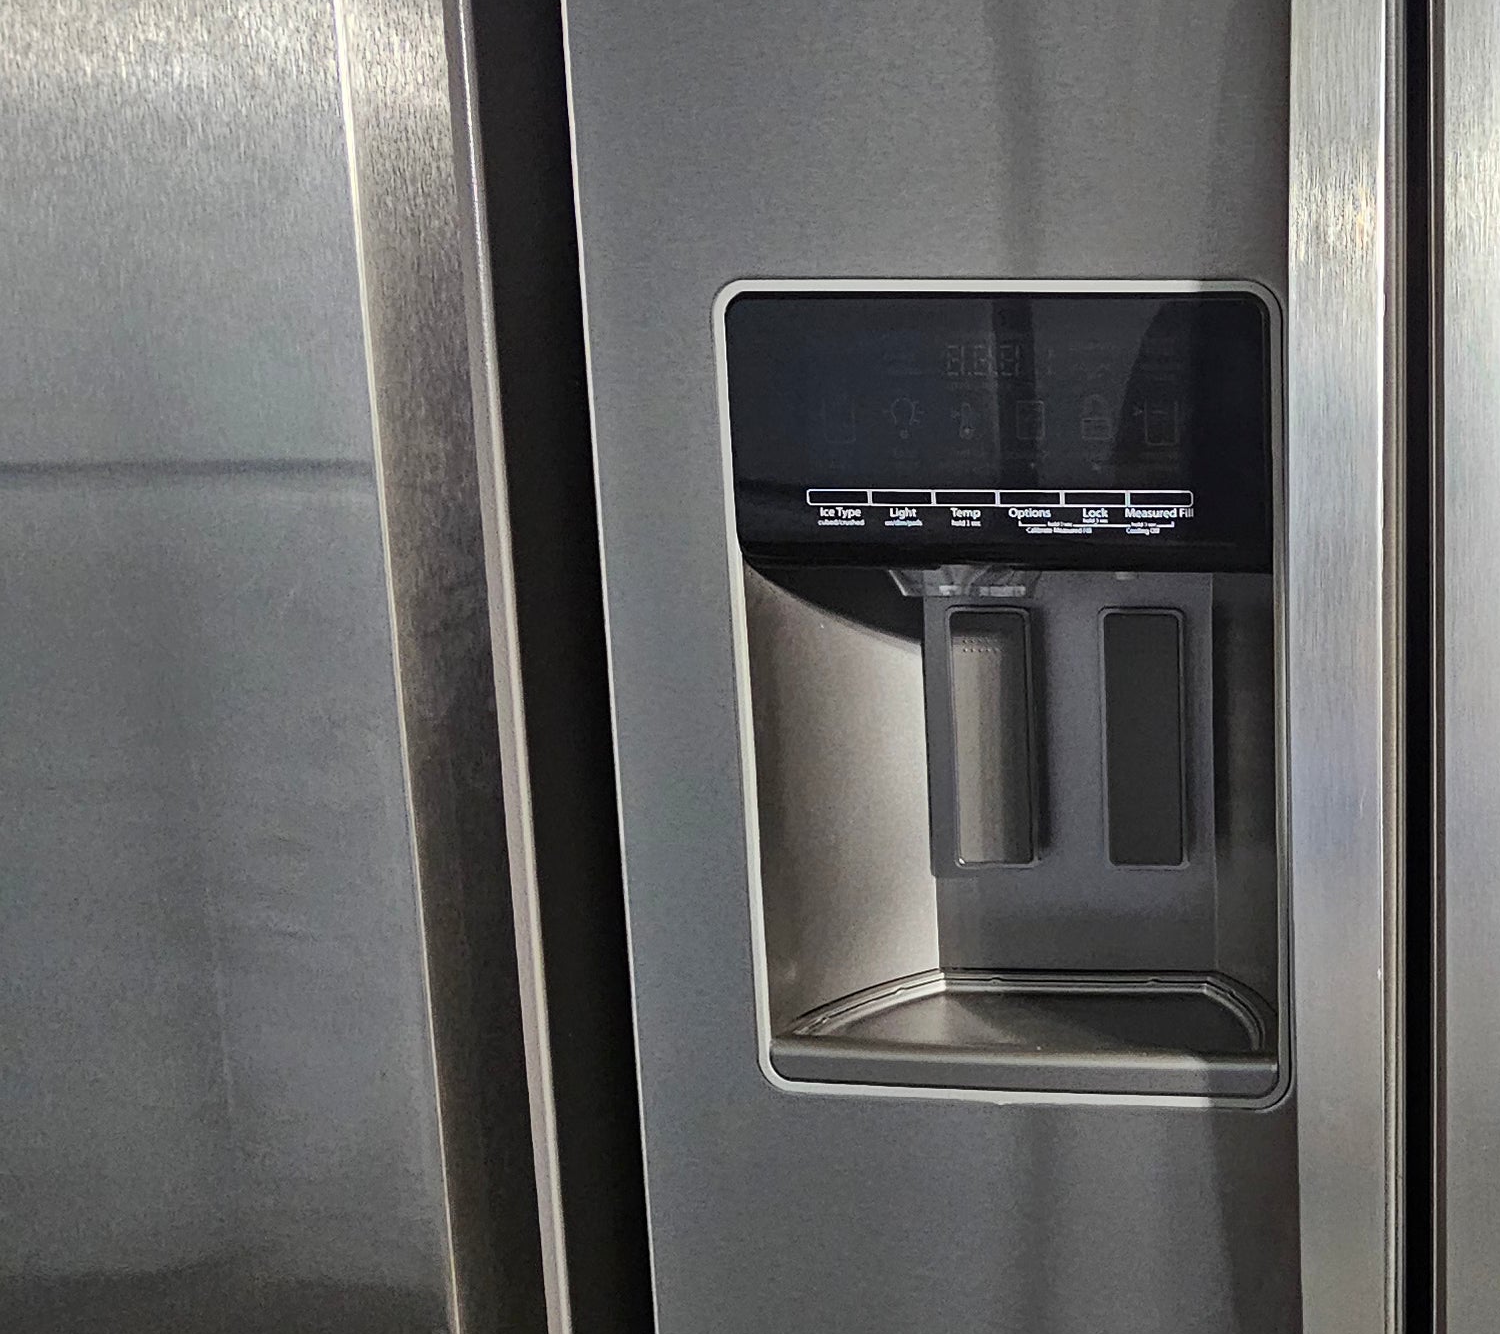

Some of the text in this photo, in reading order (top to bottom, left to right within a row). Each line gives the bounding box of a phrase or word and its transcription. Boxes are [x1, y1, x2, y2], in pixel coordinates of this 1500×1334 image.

[820, 507, 862, 519] Ice Type
[889, 507, 917, 520] Light
[950, 507, 981, 520] Temp
[1008, 507, 1052, 520] Options
[1082, 507, 1109, 518] Lock
[1124, 507, 1194, 518] Measured Fill
